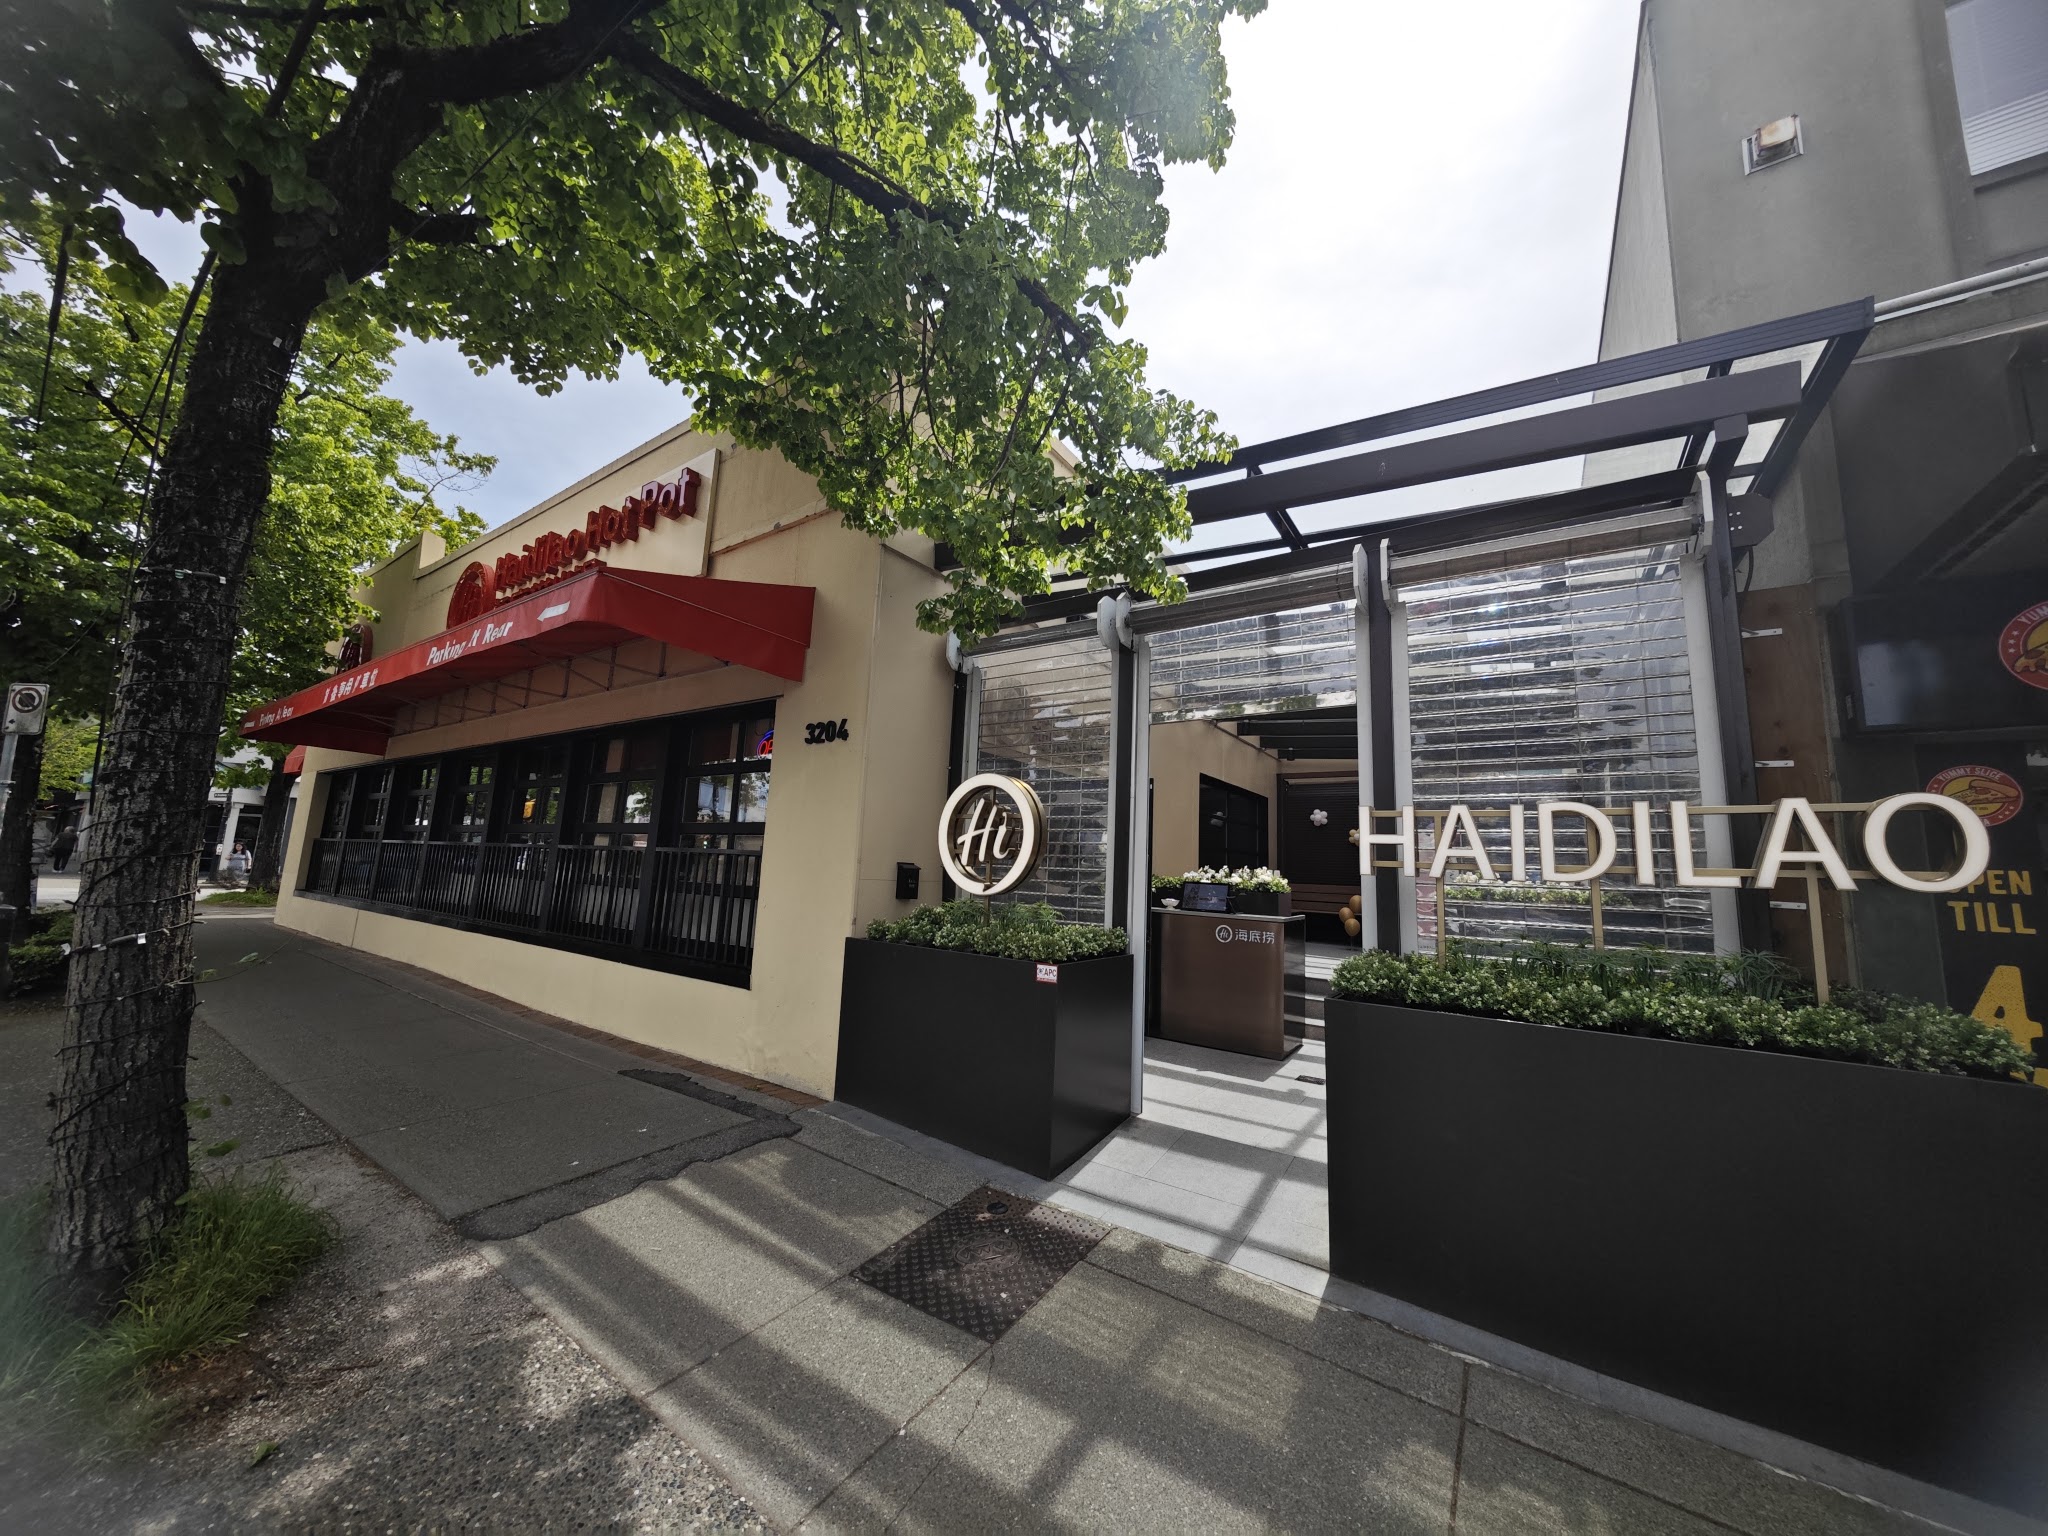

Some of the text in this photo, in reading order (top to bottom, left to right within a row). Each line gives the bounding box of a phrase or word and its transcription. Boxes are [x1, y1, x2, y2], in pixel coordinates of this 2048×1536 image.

[585, 495, 642, 554] Hot
[640, 467, 701, 531] Pot
[482, 621, 513, 645] Rear
[804, 718, 849, 745] 3204
[1937, 767, 2002, 782] YUMMY SLICE
[1358, 792, 1991, 893] HAIDILAO
[1949, 869, 2033, 896] PEN
[1946, 900, 2037, 935] TILL
[1234, 928, 1275, 944] 海底捞
[1044, 968, 1057, 978] APC
[1970, 964, 2044, 1057] 4
